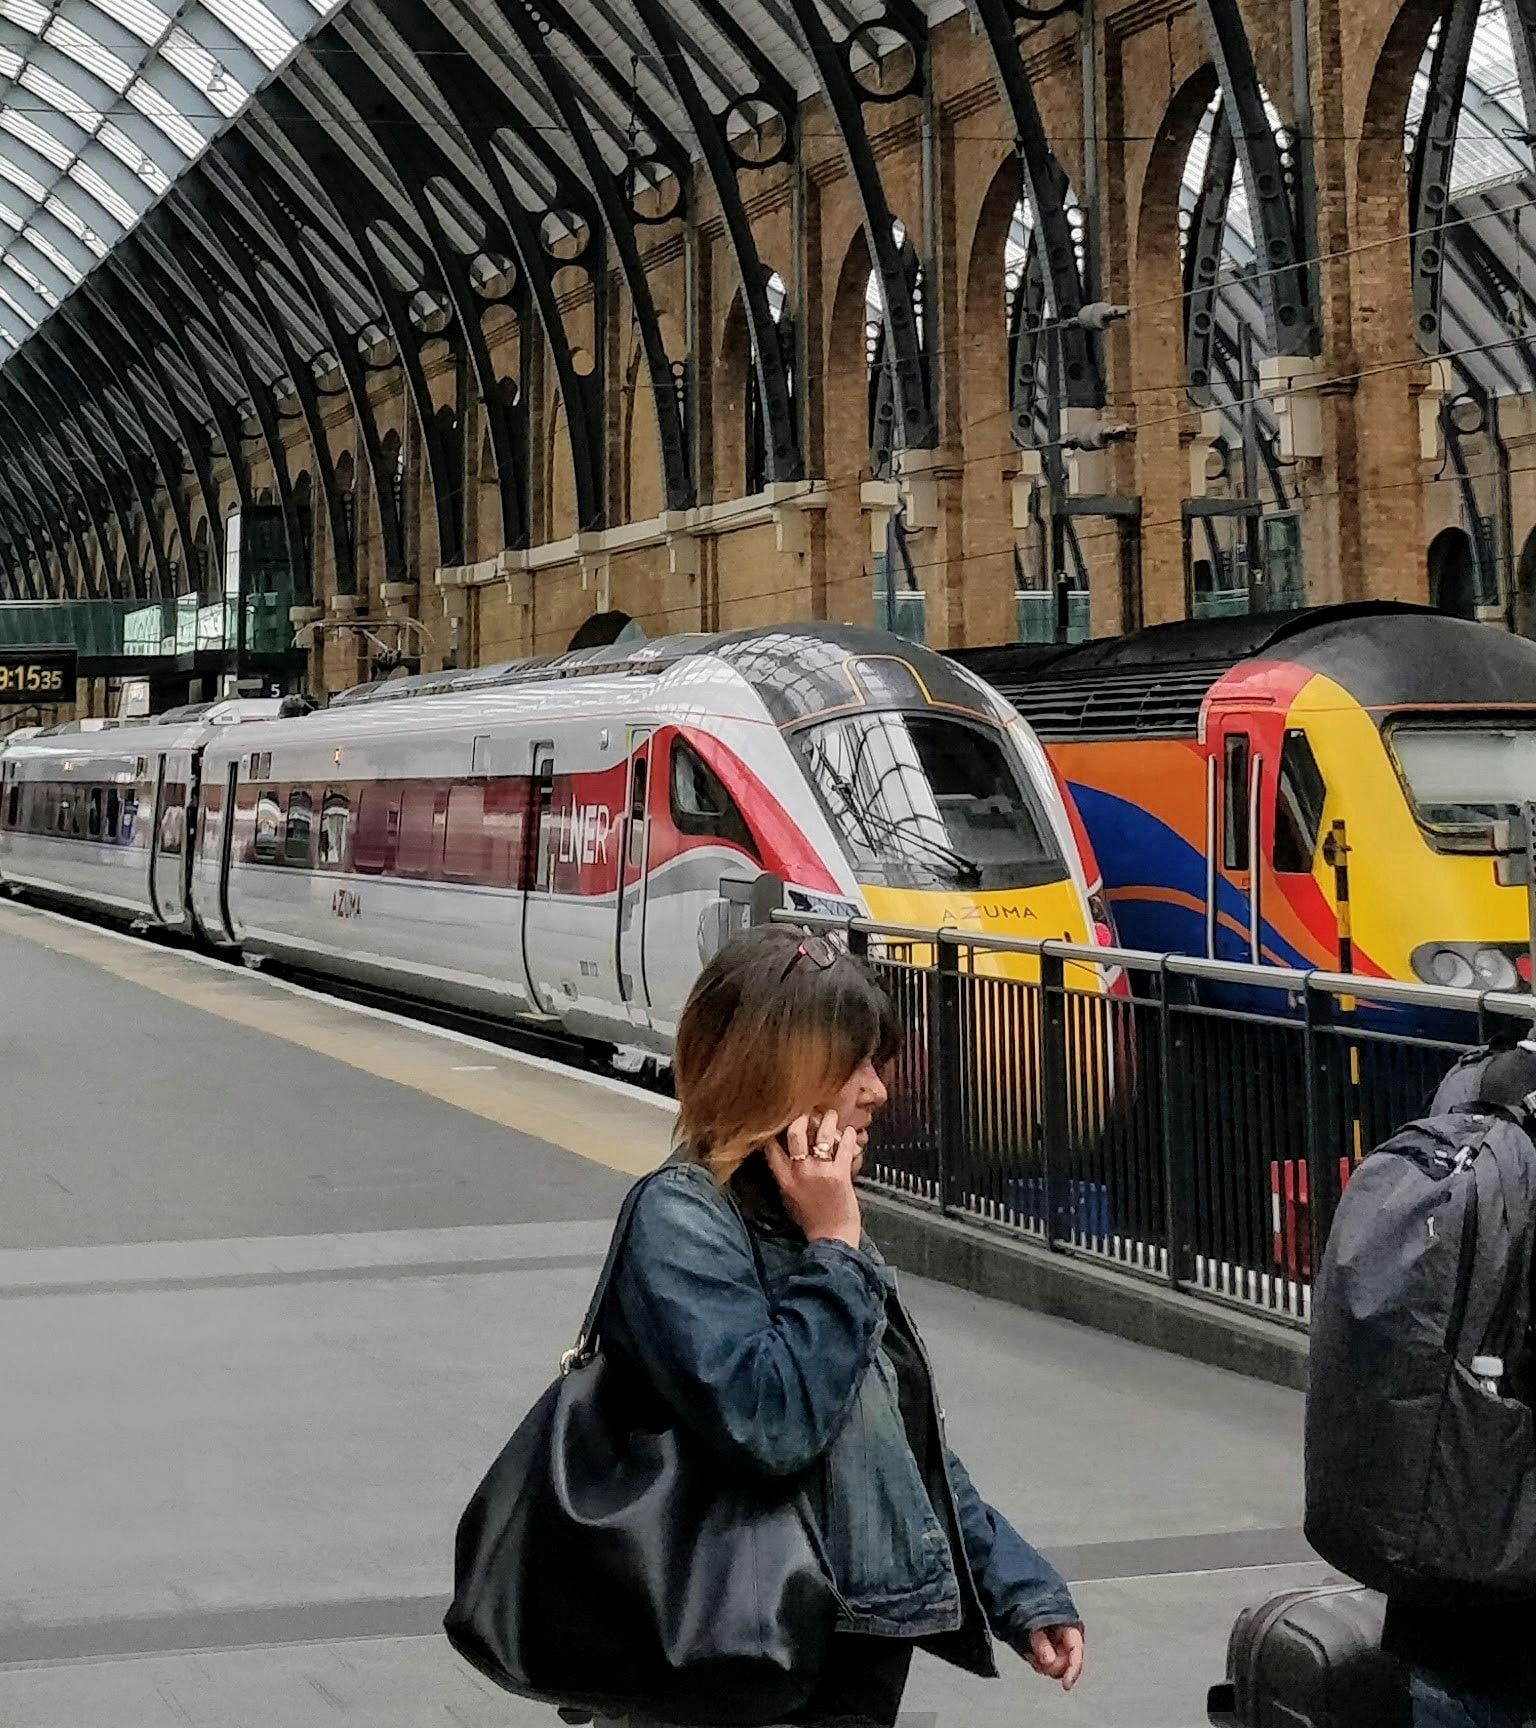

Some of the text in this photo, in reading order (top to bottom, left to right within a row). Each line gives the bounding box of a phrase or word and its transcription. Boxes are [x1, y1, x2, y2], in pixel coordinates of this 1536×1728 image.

[270, 683, 281, 698] 5
[559, 793, 609, 874] LNER
[943, 905, 1038, 922] AZUMA
